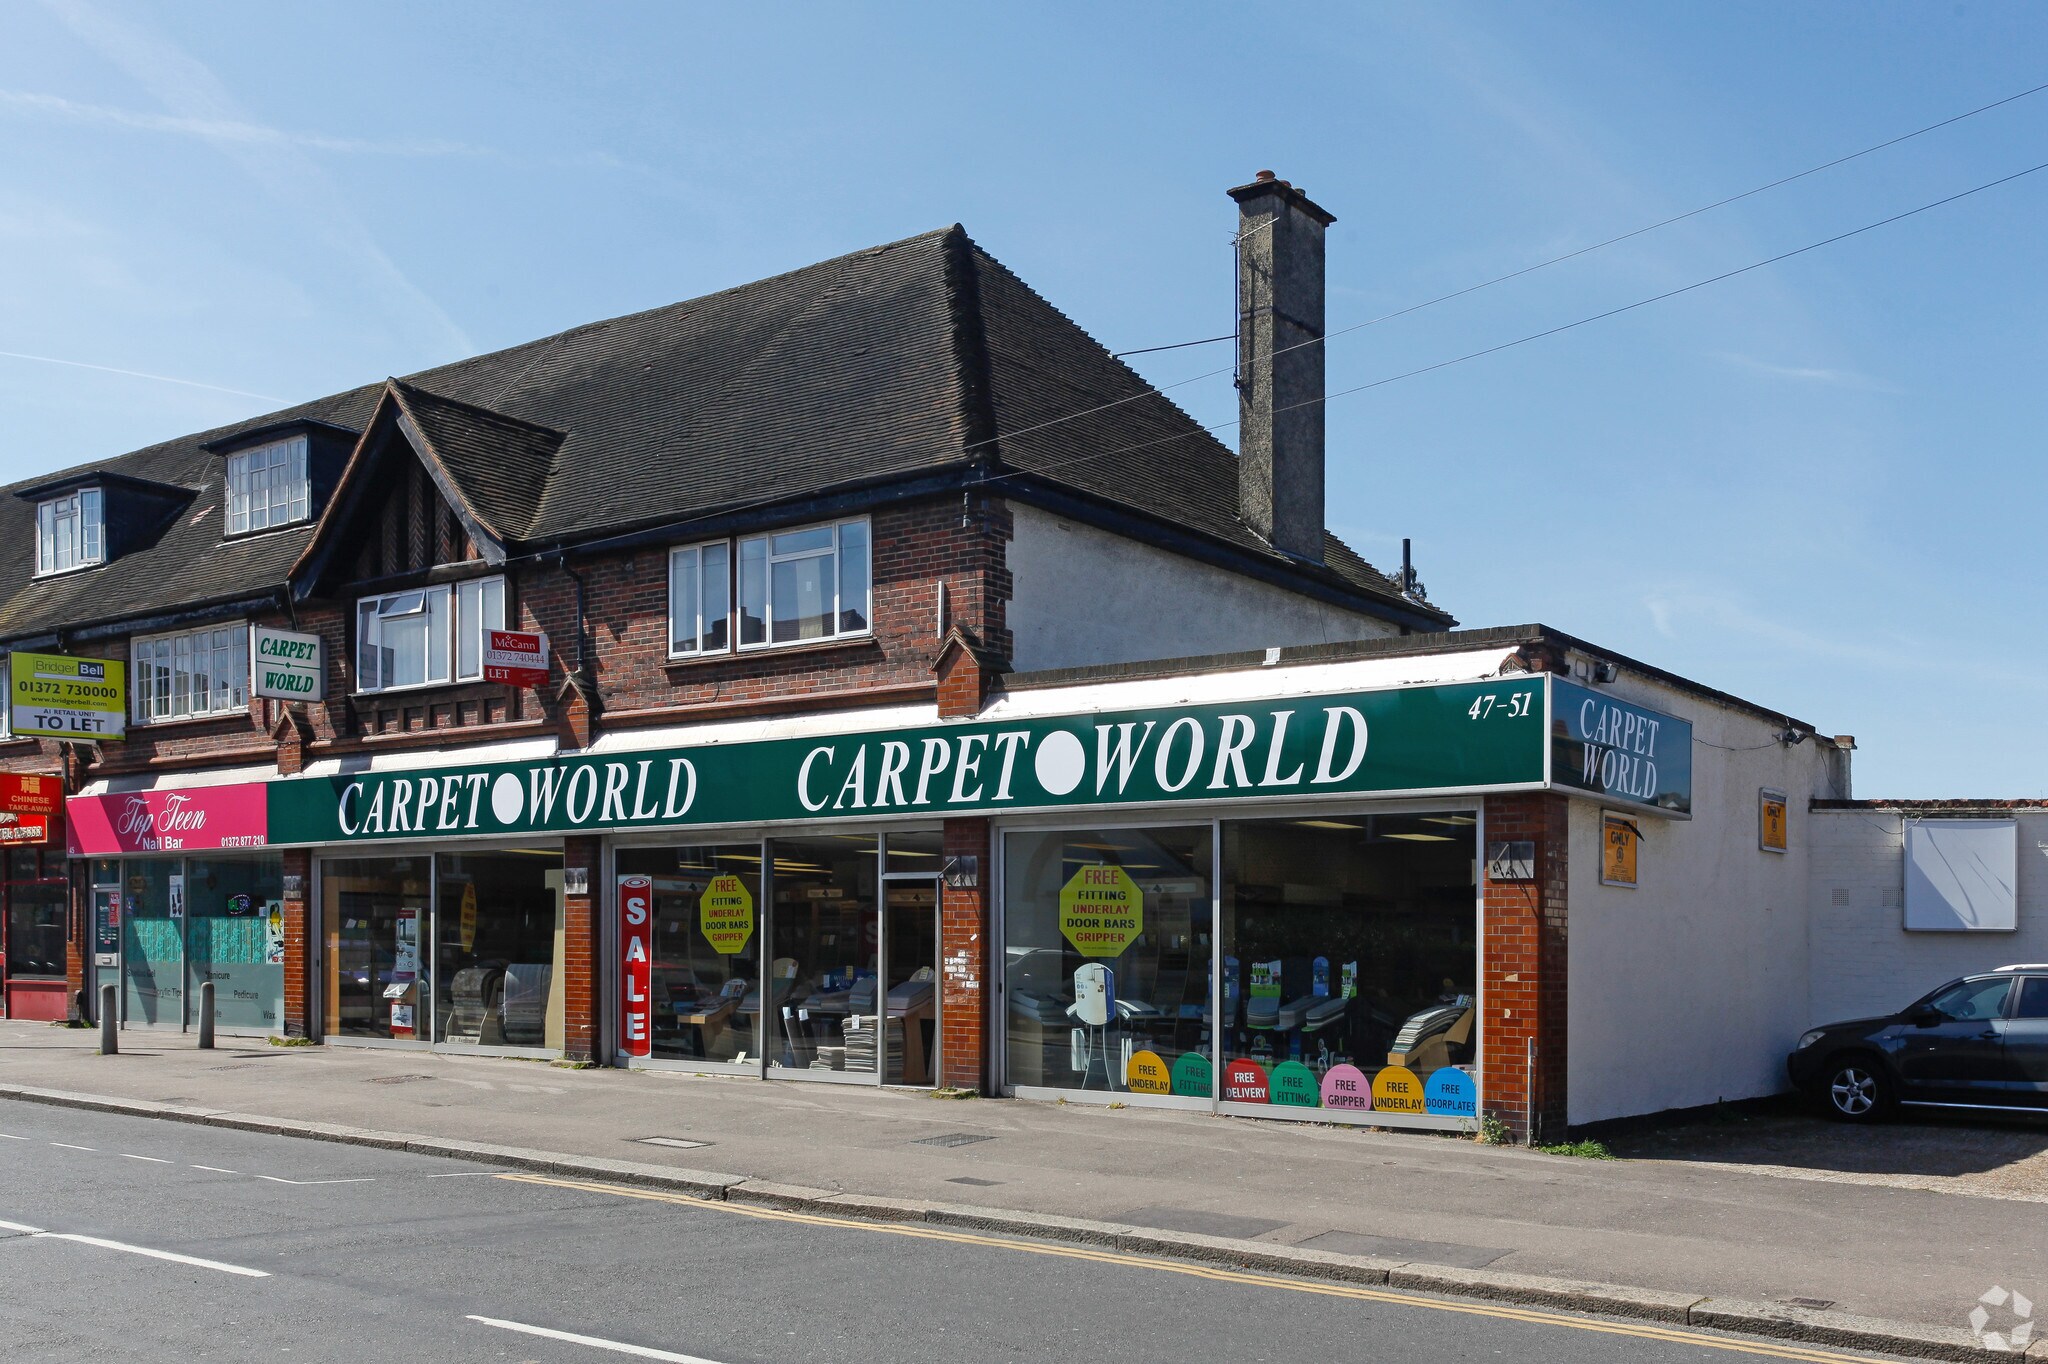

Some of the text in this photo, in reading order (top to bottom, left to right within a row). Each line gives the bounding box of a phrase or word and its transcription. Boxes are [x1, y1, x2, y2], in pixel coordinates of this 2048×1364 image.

[260, 638, 316, 660] CARPET
[495, 638, 536, 650] McCann
[486, 650, 544, 664] 01372 740444
[36, 660, 103, 676] Bridger Bell
[488, 668, 510, 678] LET
[265, 672, 314, 692] WORLD
[20, 681, 118, 698] 01372 730000
[31, 696, 108, 707] www.bridgerbell.com
[1468, 692, 1532, 720] 47-51
[34, 715, 105, 732] TO LET
[1580, 698, 1660, 758] CARPET
[798, 706, 1368, 812] CARPET WORLD
[1583, 742, 1657, 800] WORLD
[11, 795, 50, 804] CHINESE
[339, 758, 697, 836] CARPET WORLD
[8, 804, 53, 812] TAKE-AWAY
[118, 792, 207, 845] Top Teen
[142, 836, 183, 850] Nail Bar
[221, 836, 239, 847] 01372
[240, 836, 252, 846] 877
[1610, 830, 1630, 846] ONLY
[1085, 870, 1119, 884] FREE
[716, 879, 737, 892] FREE
[1078, 890, 1126, 900] FITTING
[712, 897, 742, 906] FITTING
[708, 909, 744, 918] UNDERLAY
[1072, 904, 1130, 914] UNDERLAY
[729, 921, 749, 929] BARS
[1066, 918, 1136, 928] DOOR BARS
[712, 933, 743, 941] GRIPPER
[1076, 932, 1126, 942] GRIPPER
[205, 970, 230, 980] Manicure
[626, 898, 647, 1041] SALE
[234, 990, 258, 999] Pedicure
[263, 1010, 276, 1020] Wax
[1138, 1065, 1157, 1076] FREE
[1185, 1066, 1206, 1078] FREE
[1234, 1072, 1255, 1083] FREE
[1282, 1077, 1303, 1088] FREE
[1129, 1080, 1169, 1091] UNDERLAY
[1180, 1080, 1212, 1093] FITTING
[1335, 1079, 1356, 1091] FREE
[1386, 1082, 1408, 1093] FREE
[1441, 1083, 1460, 1094] FREE
[1226, 1087, 1266, 1098] DELIVERY
[1277, 1092, 1310, 1104] FITTING
[1328, 1094, 1366, 1108] GRIPPER
[1375, 1098, 1422, 1110] UNDERLAY
[1426, 1098, 1476, 1111] DOORPLATES
